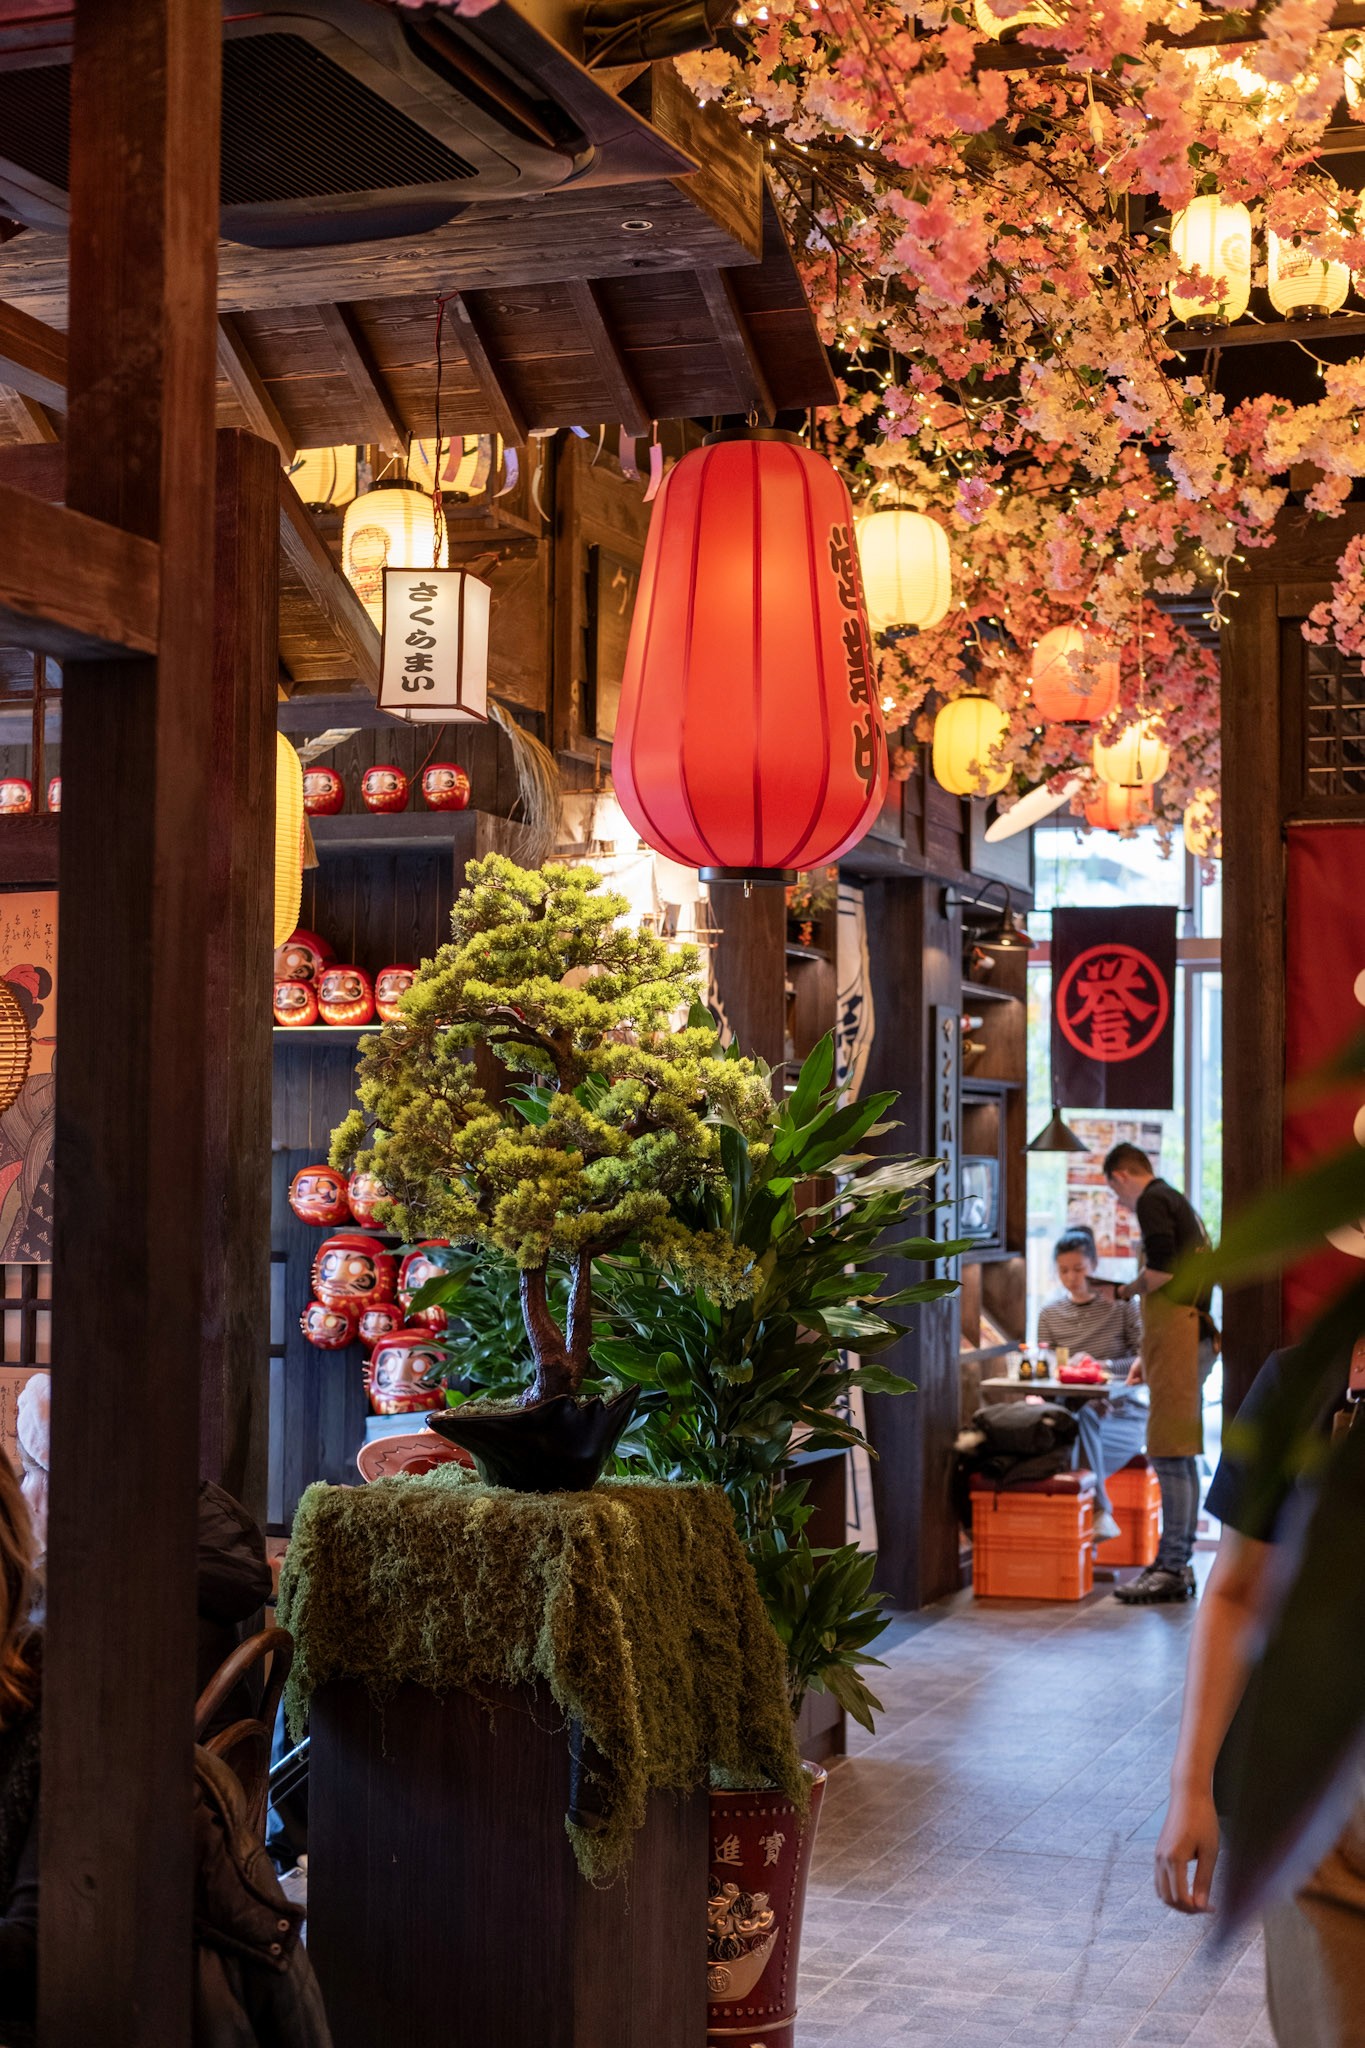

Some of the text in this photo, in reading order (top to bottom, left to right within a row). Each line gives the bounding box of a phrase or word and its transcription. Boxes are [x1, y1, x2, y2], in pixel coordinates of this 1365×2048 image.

[401, 581, 439, 693] さくらまい
